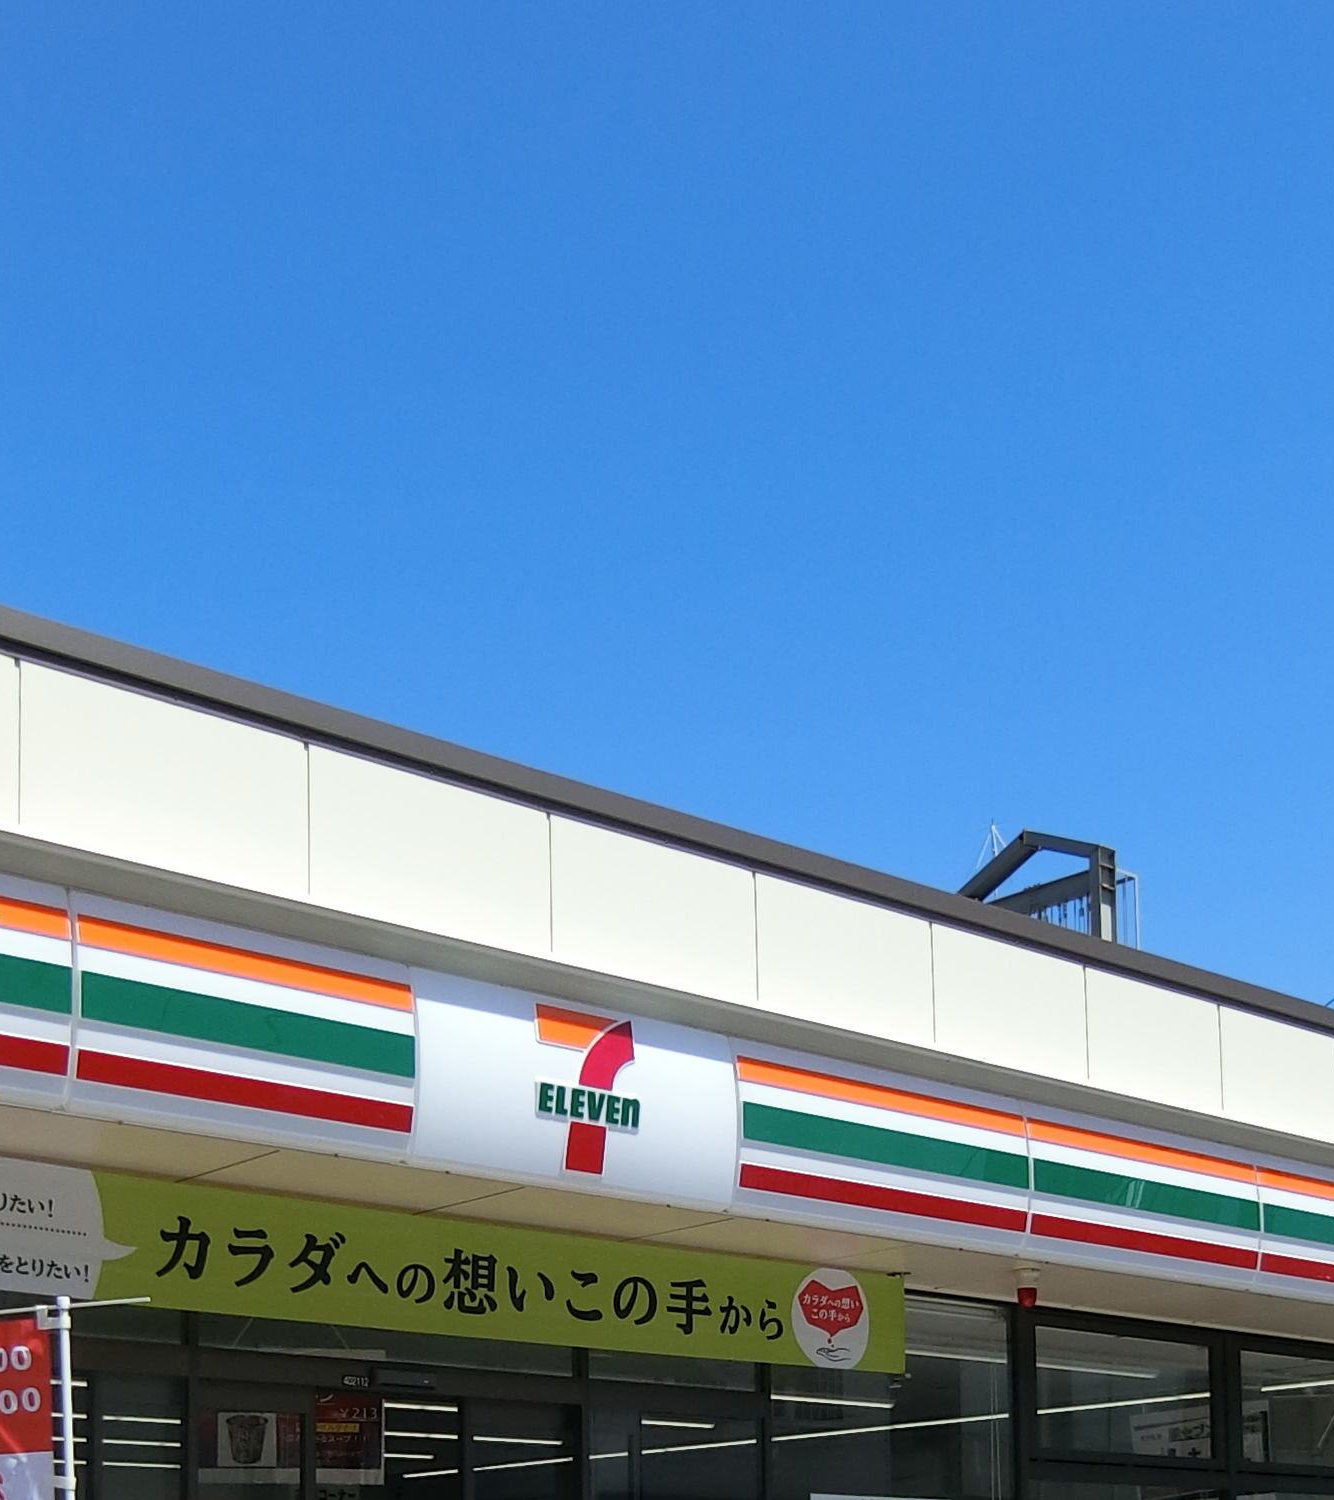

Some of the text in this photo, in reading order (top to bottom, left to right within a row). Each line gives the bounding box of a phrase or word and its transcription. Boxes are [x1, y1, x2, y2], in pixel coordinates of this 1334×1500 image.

[155, 1215, 785, 1341] カラダへの想いこの手から
[802, 1293, 860, 1310] カラダへの想い
[811, 1308, 852, 1323] この手から
